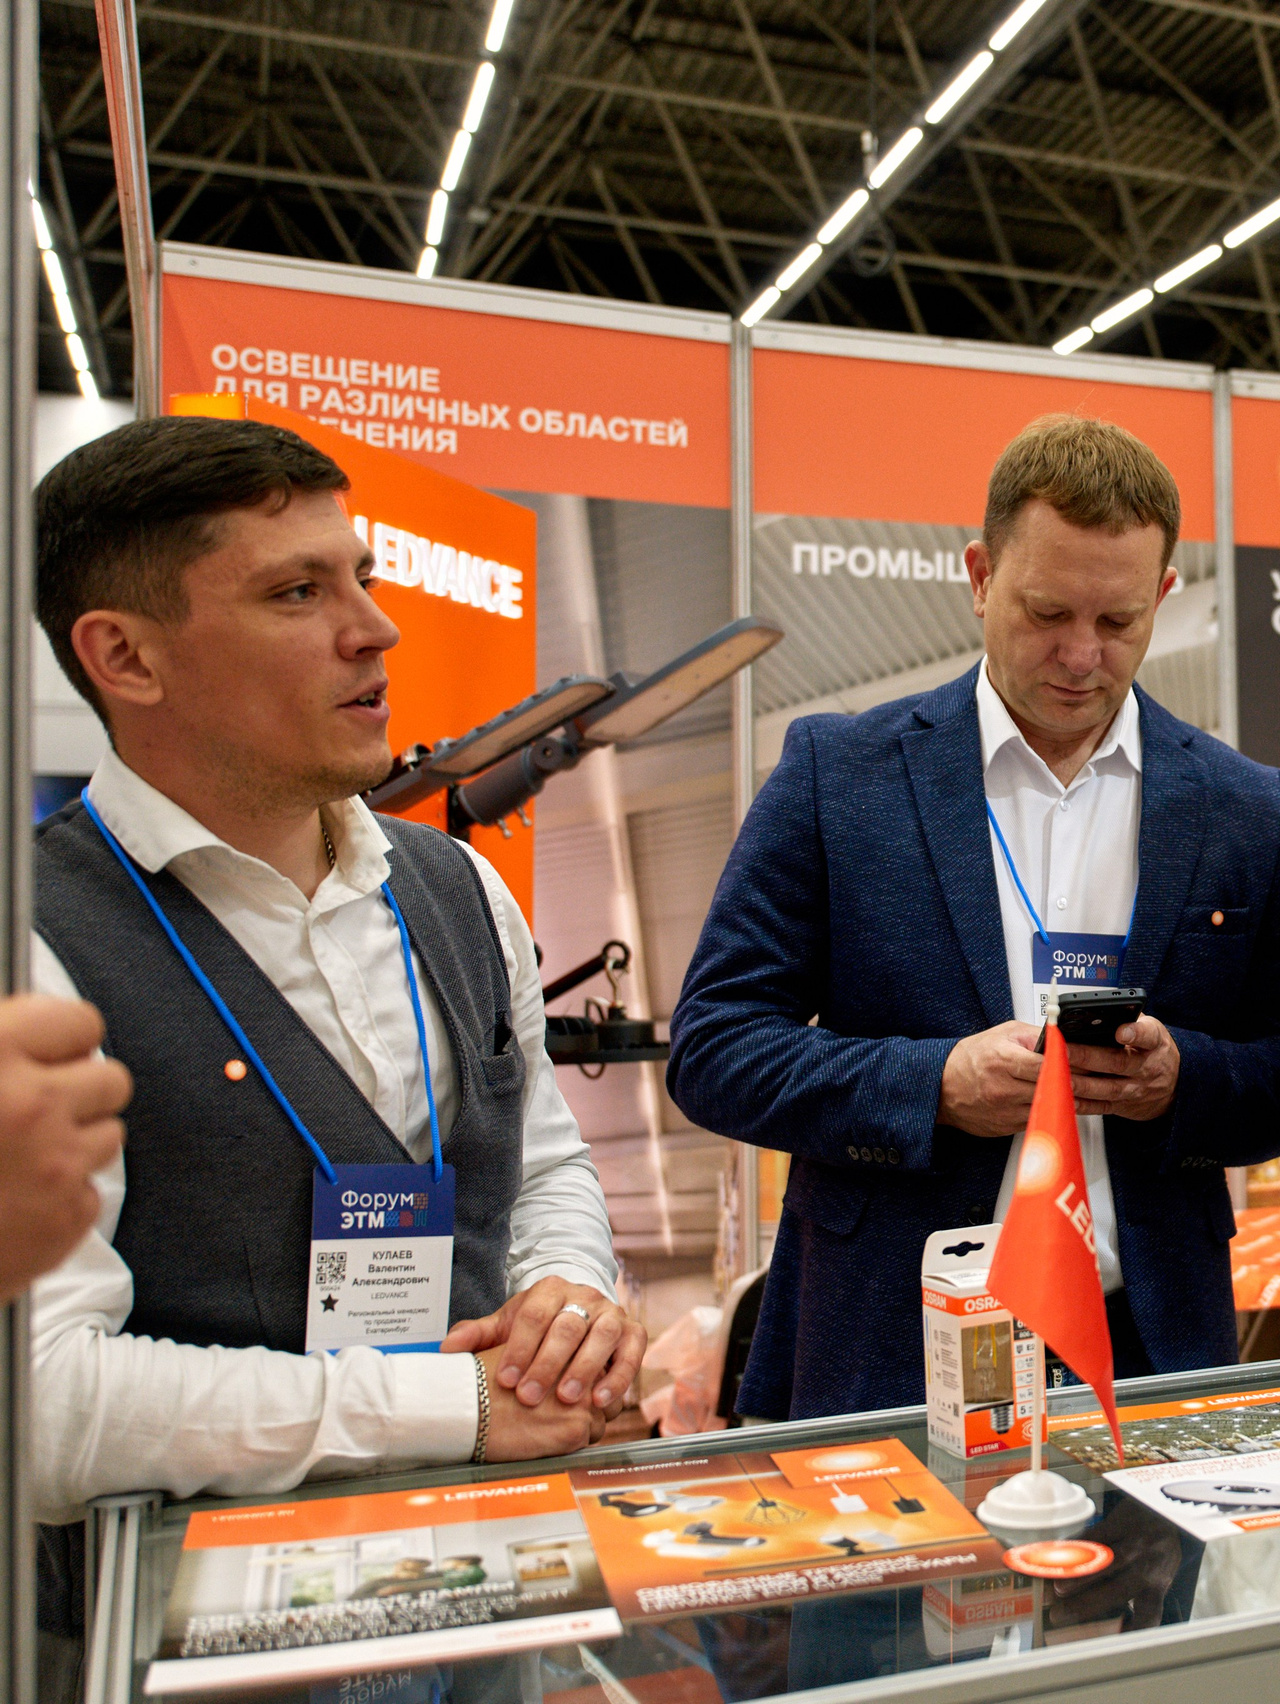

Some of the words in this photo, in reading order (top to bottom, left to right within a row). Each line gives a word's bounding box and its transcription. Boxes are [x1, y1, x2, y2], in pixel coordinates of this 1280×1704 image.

[211, 343, 441, 394] ОСВЕЩЕНИЕ
[214, 375, 290, 408] ДЛЯ
[300, 384, 511, 431] РАЗЛИЧНЫХ
[518, 406, 689, 448] ОБЛАСТЕЙ
[353, 514, 523, 619] LEDVANCE
[1052, 949, 1107, 966] Форум
[1053, 965, 1086, 979] ЭТМ
[341, 1190, 414, 1211] Форум
[340, 1211, 385, 1229] ЭТМ
[372, 1250, 413, 1261] КУЛАЕВ
[368, 1263, 416, 1273] Валентин
[352, 1276, 430, 1287] Александрович
[370, 1291, 409, 1300] LEDVANCE
[984, 1443, 999, 1452] STAR
[813, 1466, 901, 1483] LEDVANCE
[443, 1482, 549, 1502] LEDVANCE
